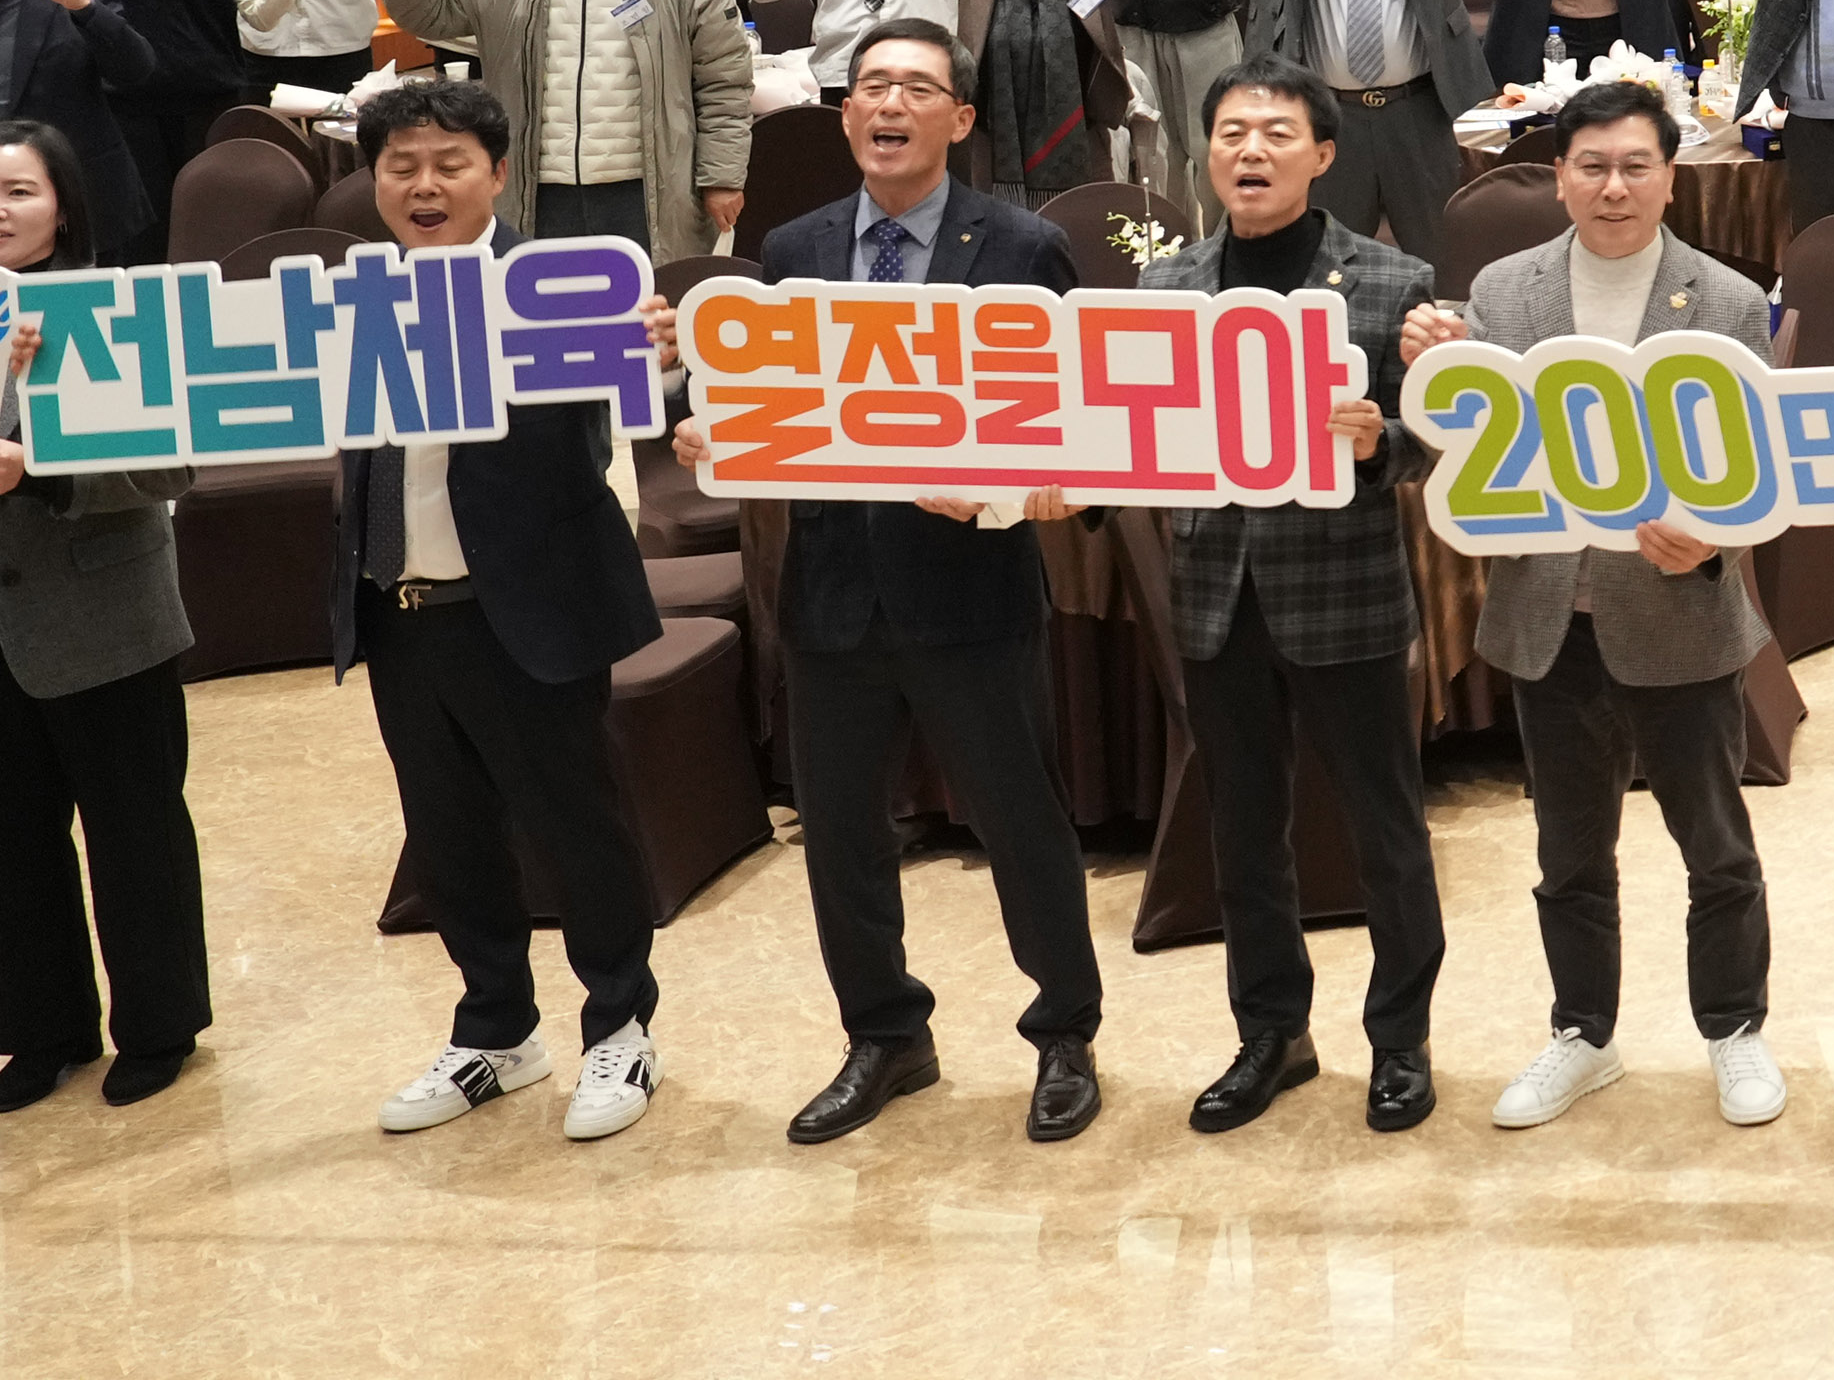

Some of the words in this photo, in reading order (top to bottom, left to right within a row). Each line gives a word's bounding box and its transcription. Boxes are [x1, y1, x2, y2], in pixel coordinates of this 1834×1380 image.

[20, 248, 654, 464] 전남체육
[693, 293, 1063, 483] 열정을
[1076, 305, 1350, 492] 모아
